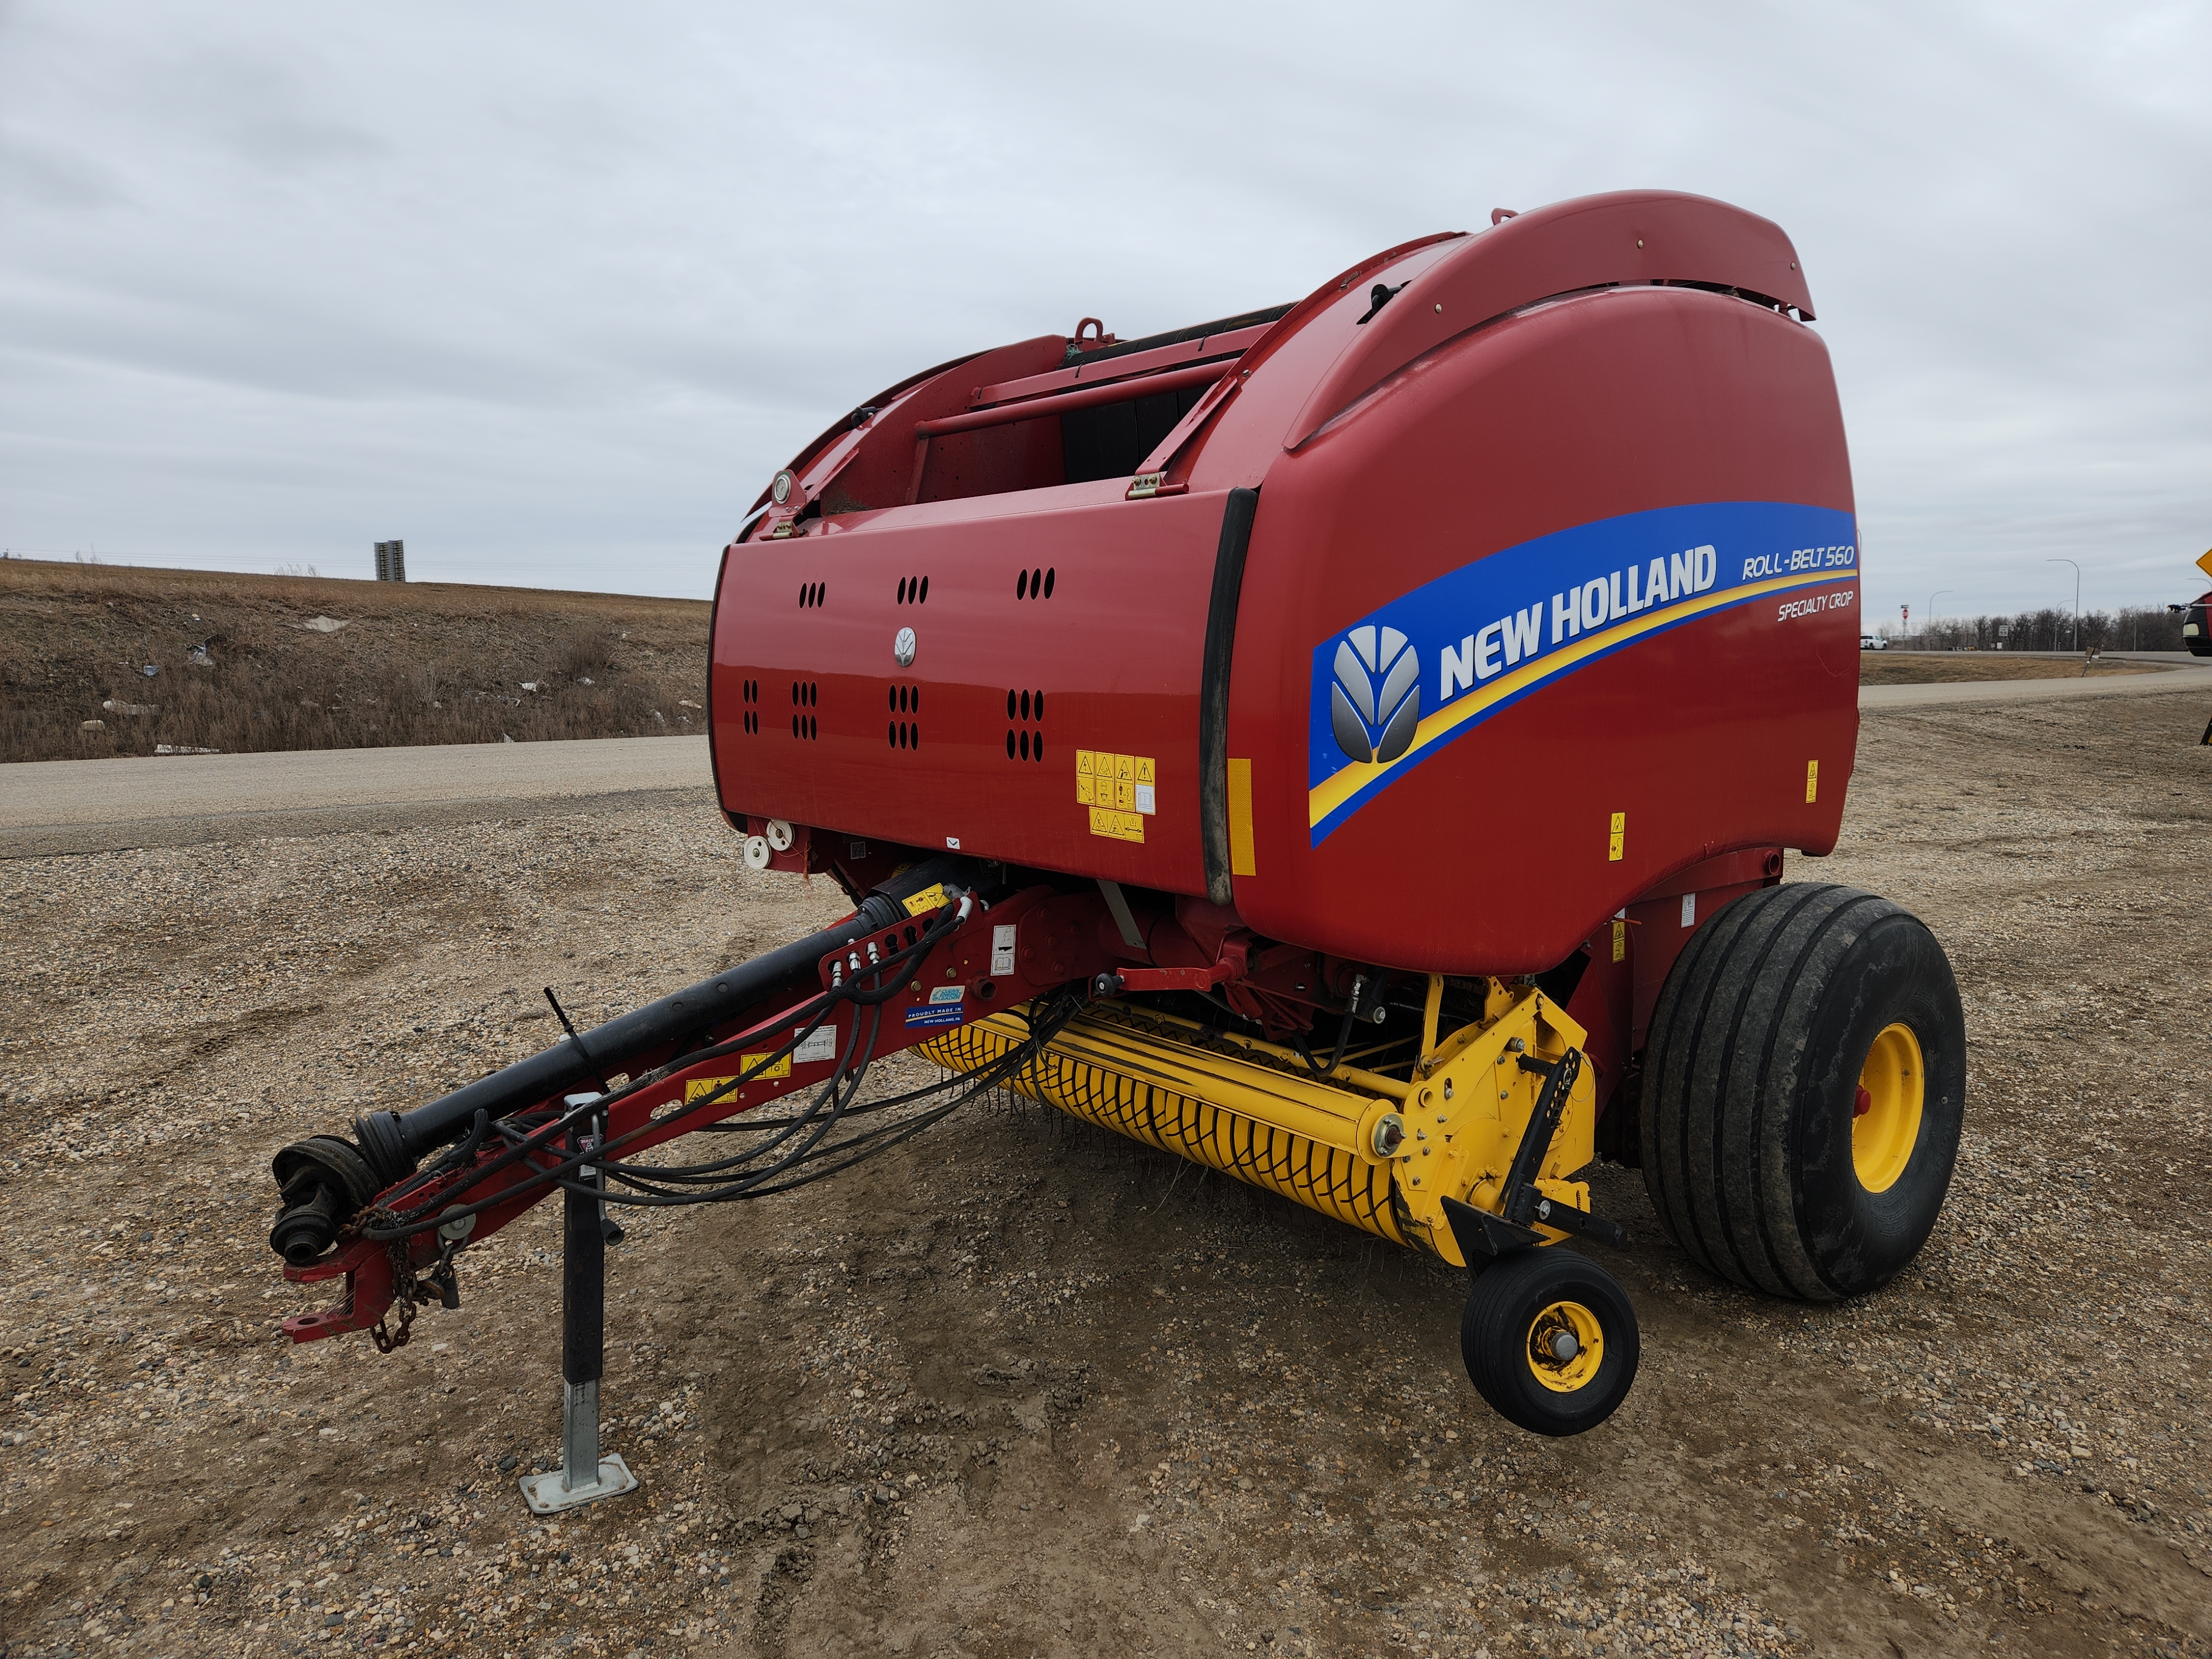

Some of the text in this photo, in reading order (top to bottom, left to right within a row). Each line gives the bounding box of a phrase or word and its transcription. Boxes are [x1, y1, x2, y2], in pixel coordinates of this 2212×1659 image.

[1743, 546, 1854, 580] ROLL-BELT 560
[1778, 591, 1854, 622] SPECIALTY CROP
[1441, 545, 1717, 701] NEW HOLLAND
[908, 1010, 935, 1019] PROUDLY
